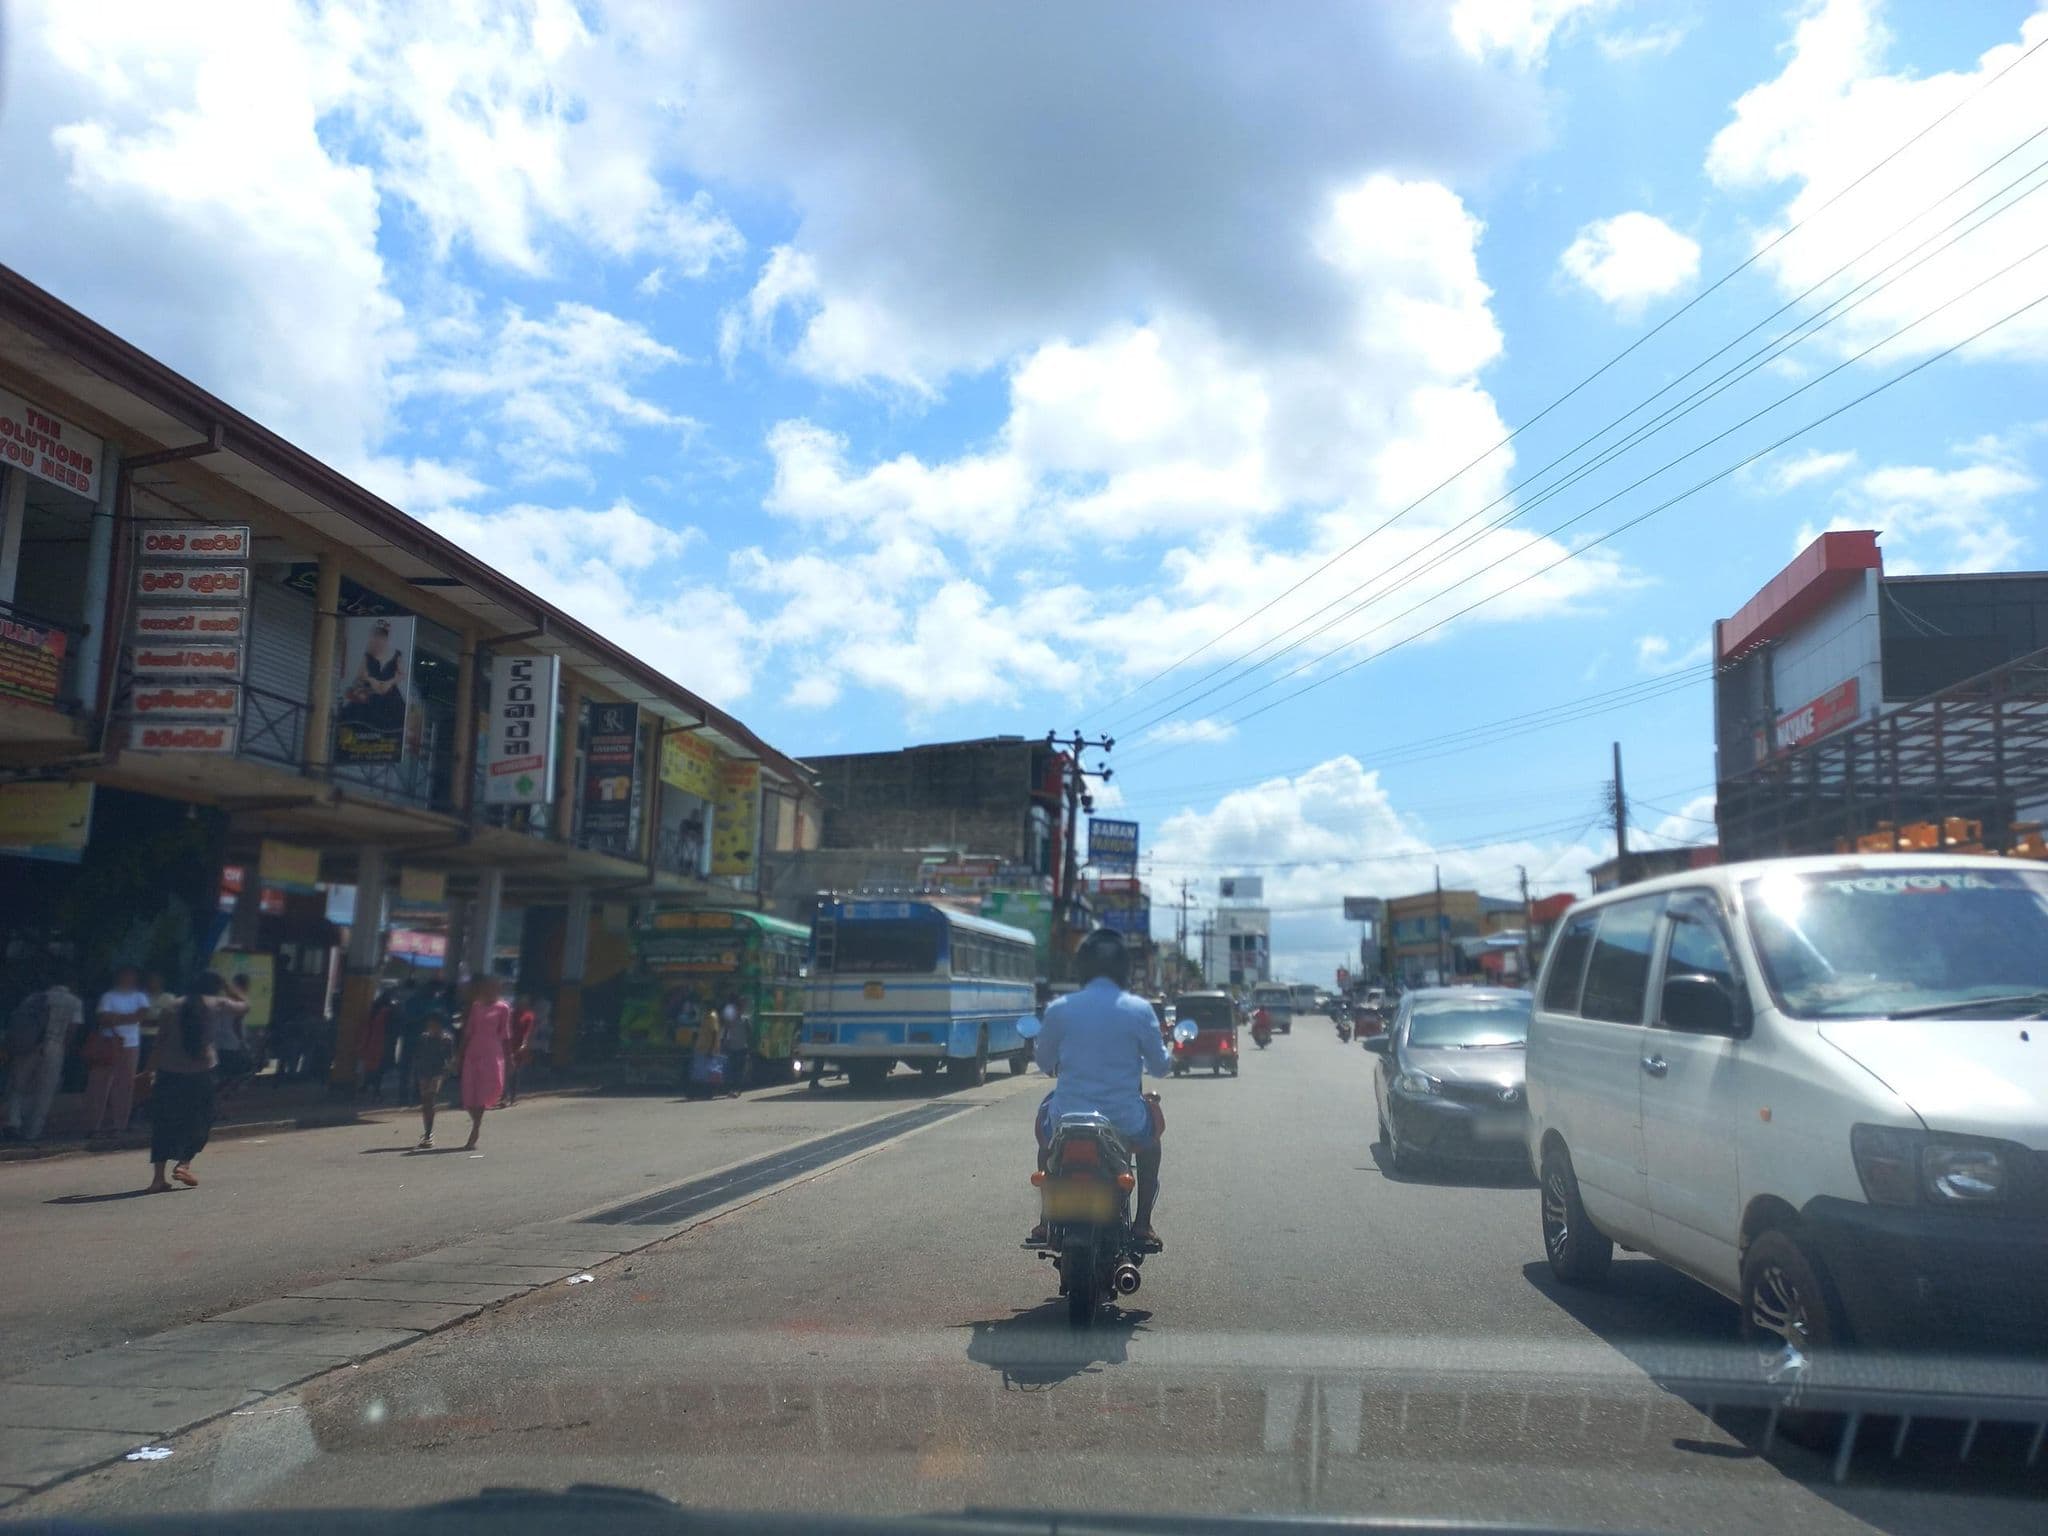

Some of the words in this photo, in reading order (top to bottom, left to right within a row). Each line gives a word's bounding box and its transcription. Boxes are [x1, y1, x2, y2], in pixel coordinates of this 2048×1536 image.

[26, 407, 61, 439] THE
[40, 457, 90, 492] NEED
[1828, 873, 1998, 894] TOYOTA
